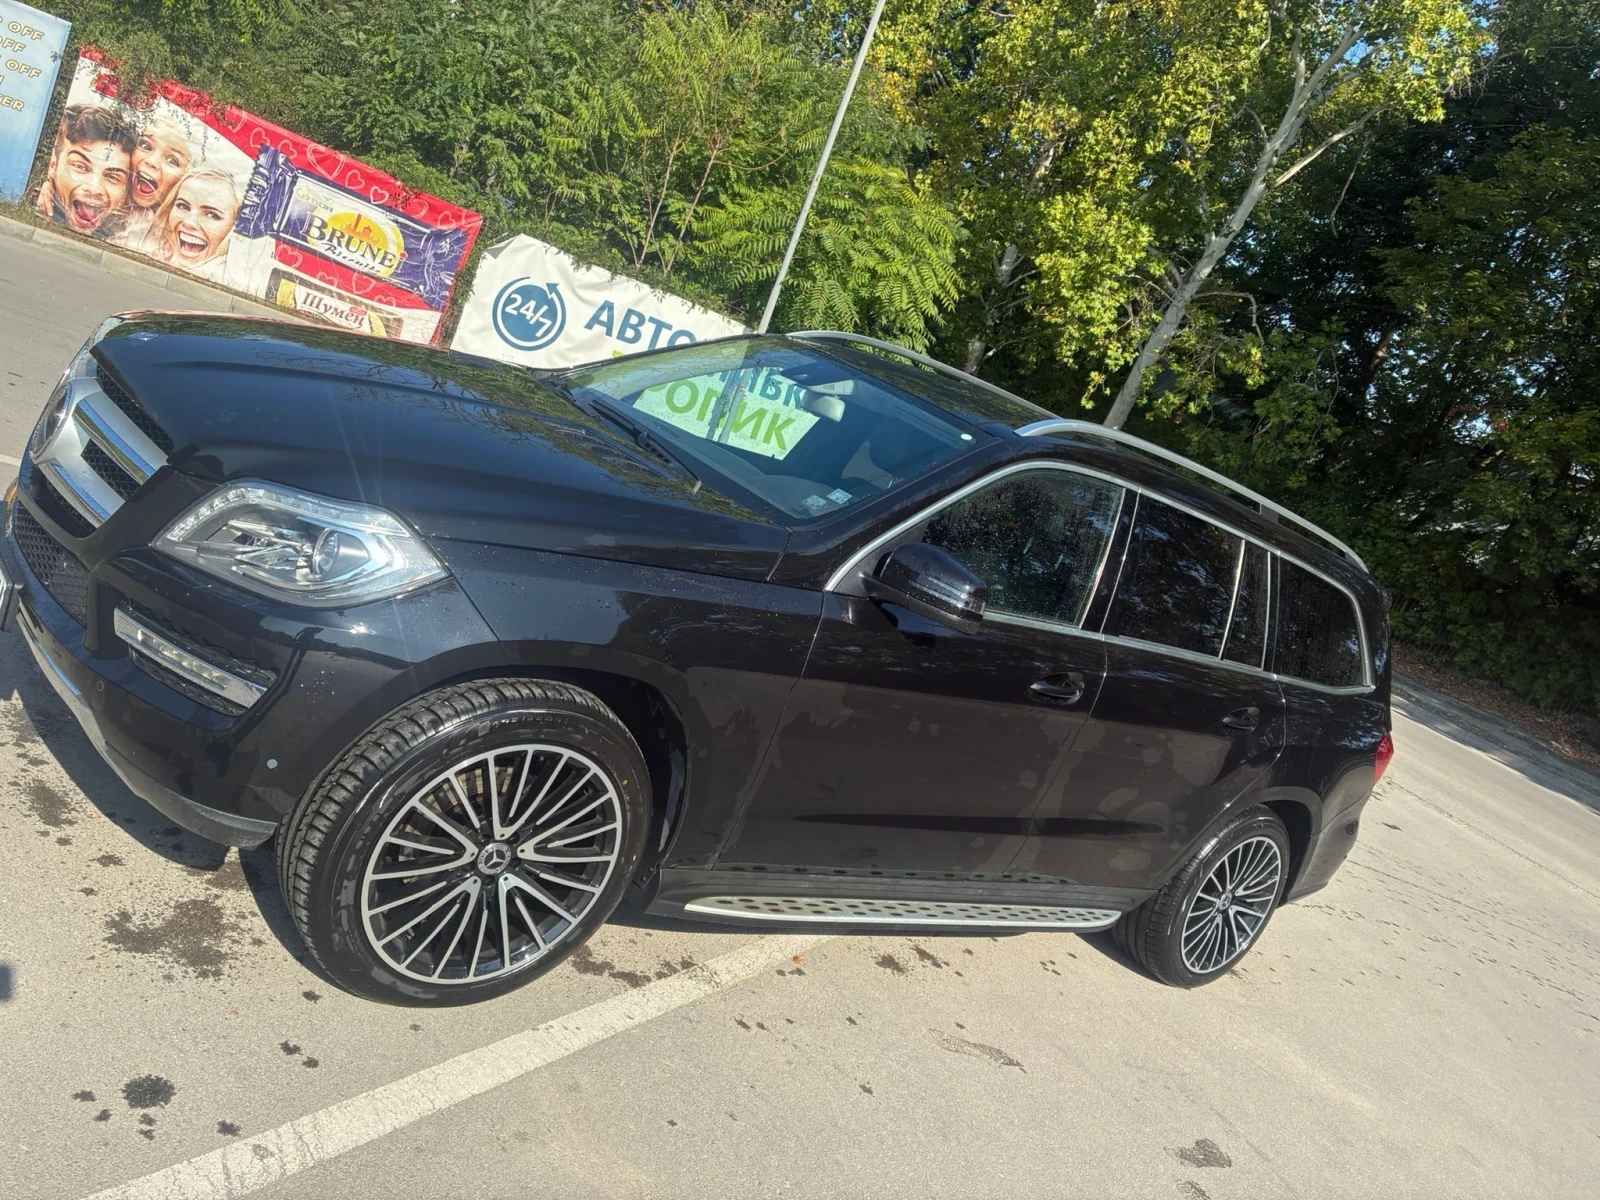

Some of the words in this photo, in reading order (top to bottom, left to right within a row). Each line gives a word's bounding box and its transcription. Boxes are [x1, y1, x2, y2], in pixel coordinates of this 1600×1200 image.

[8, 21, 45, 41] OFF
[0, 34, 26, 53] FF
[5, 59, 42, 78] OFF
[0, 92, 24, 112] ER
[300, 211, 396, 269] BRUNE
[301, 291, 365, 329] Шумен
[504, 293, 553, 338] 24/7
